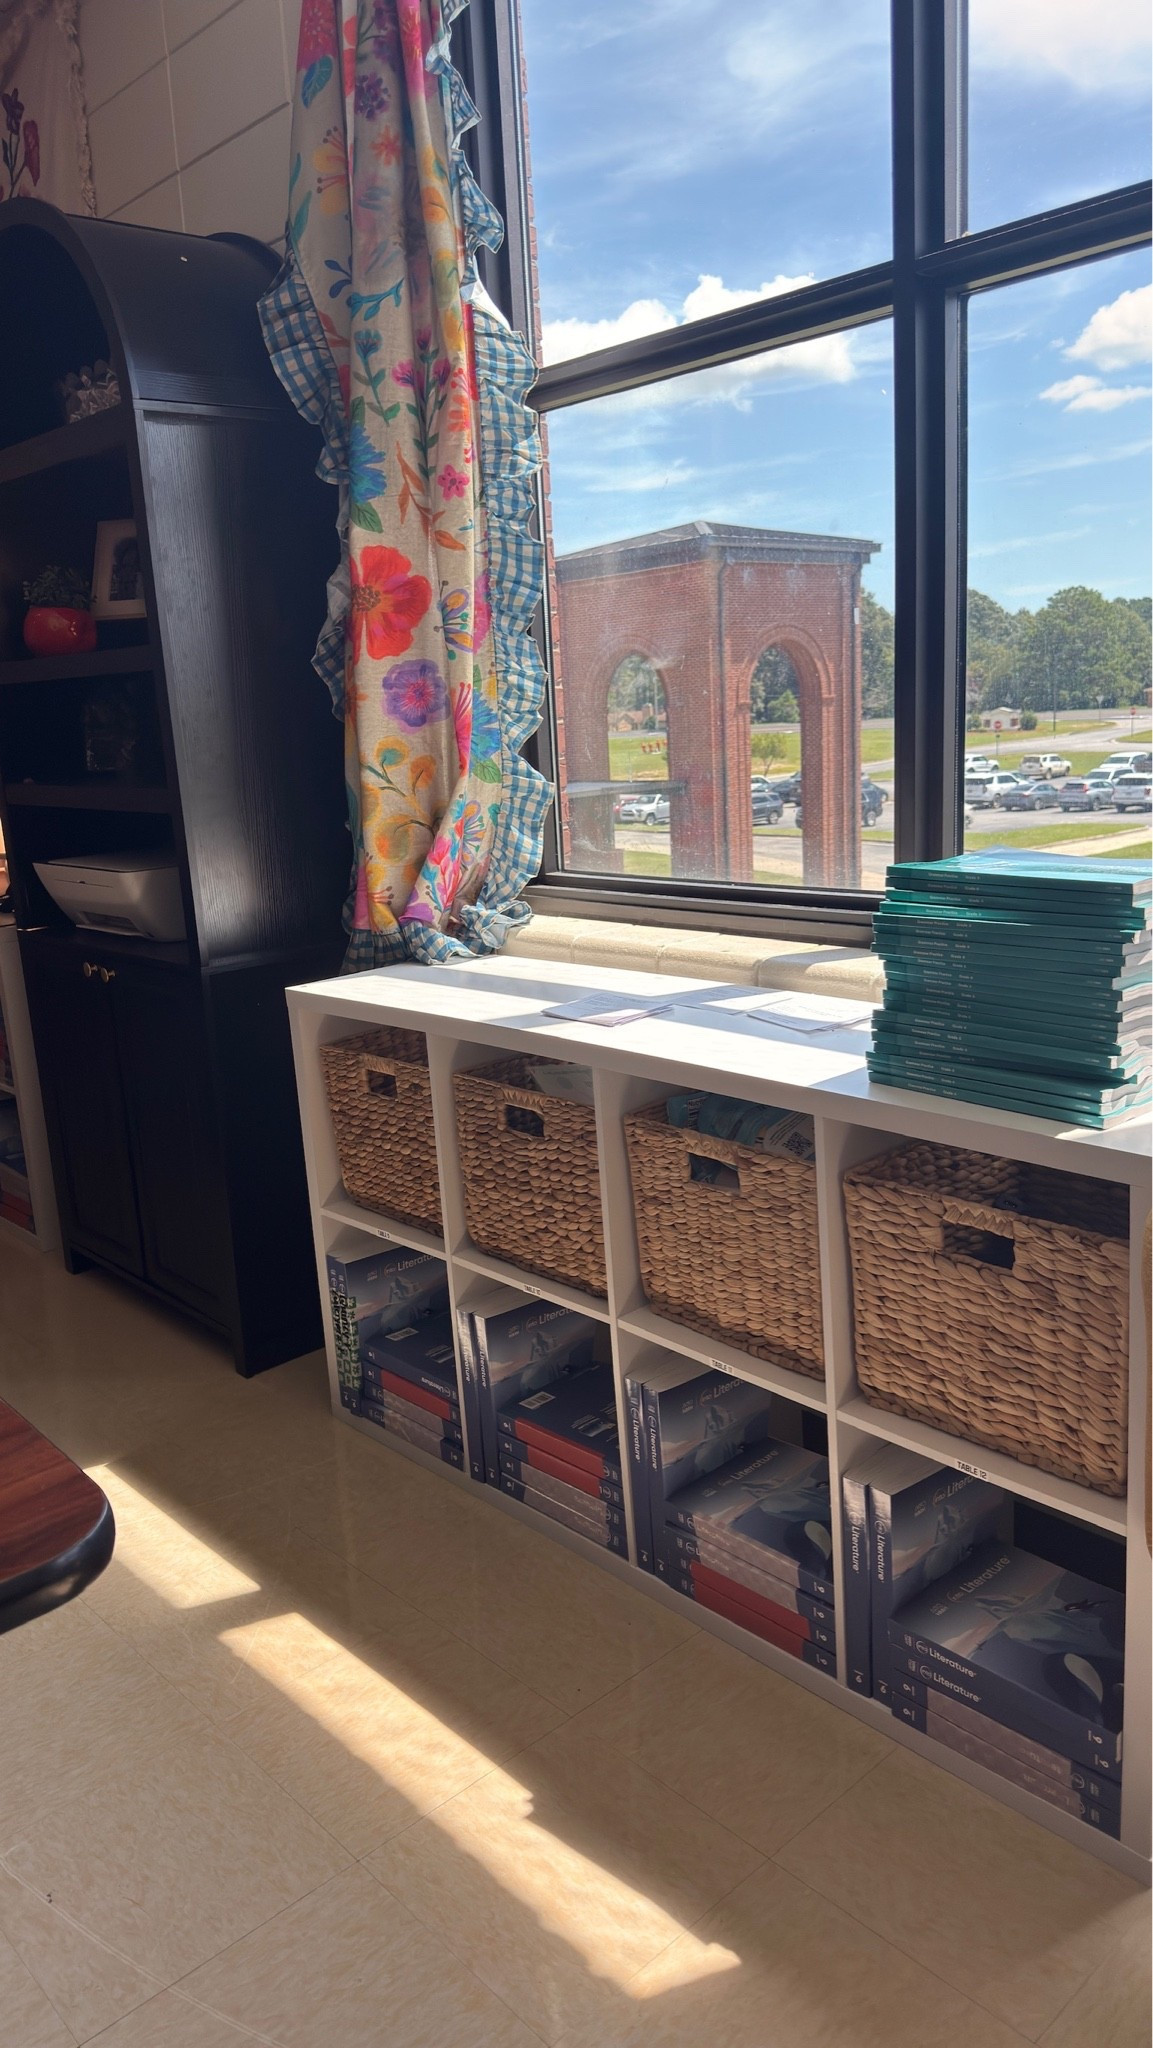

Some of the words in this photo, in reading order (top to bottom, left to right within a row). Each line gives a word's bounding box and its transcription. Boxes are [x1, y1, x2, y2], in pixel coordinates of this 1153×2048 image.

[397, 1254, 433, 1272] Literatu
[650, 1427, 658, 1469] Literature
[730, 1450, 779, 1480] Literature
[957, 1460, 978, 1476] TABLE
[979, 1469, 987, 1479] 12
[947, 1476, 974, 1498] Litera
[851, 1525, 860, 1572] Literature
[877, 1534, 885, 1581] Literature
[959, 1556, 1011, 1593] Literature
[928, 1647, 974, 1678] Literature
[933, 1671, 979, 1703] Literature
